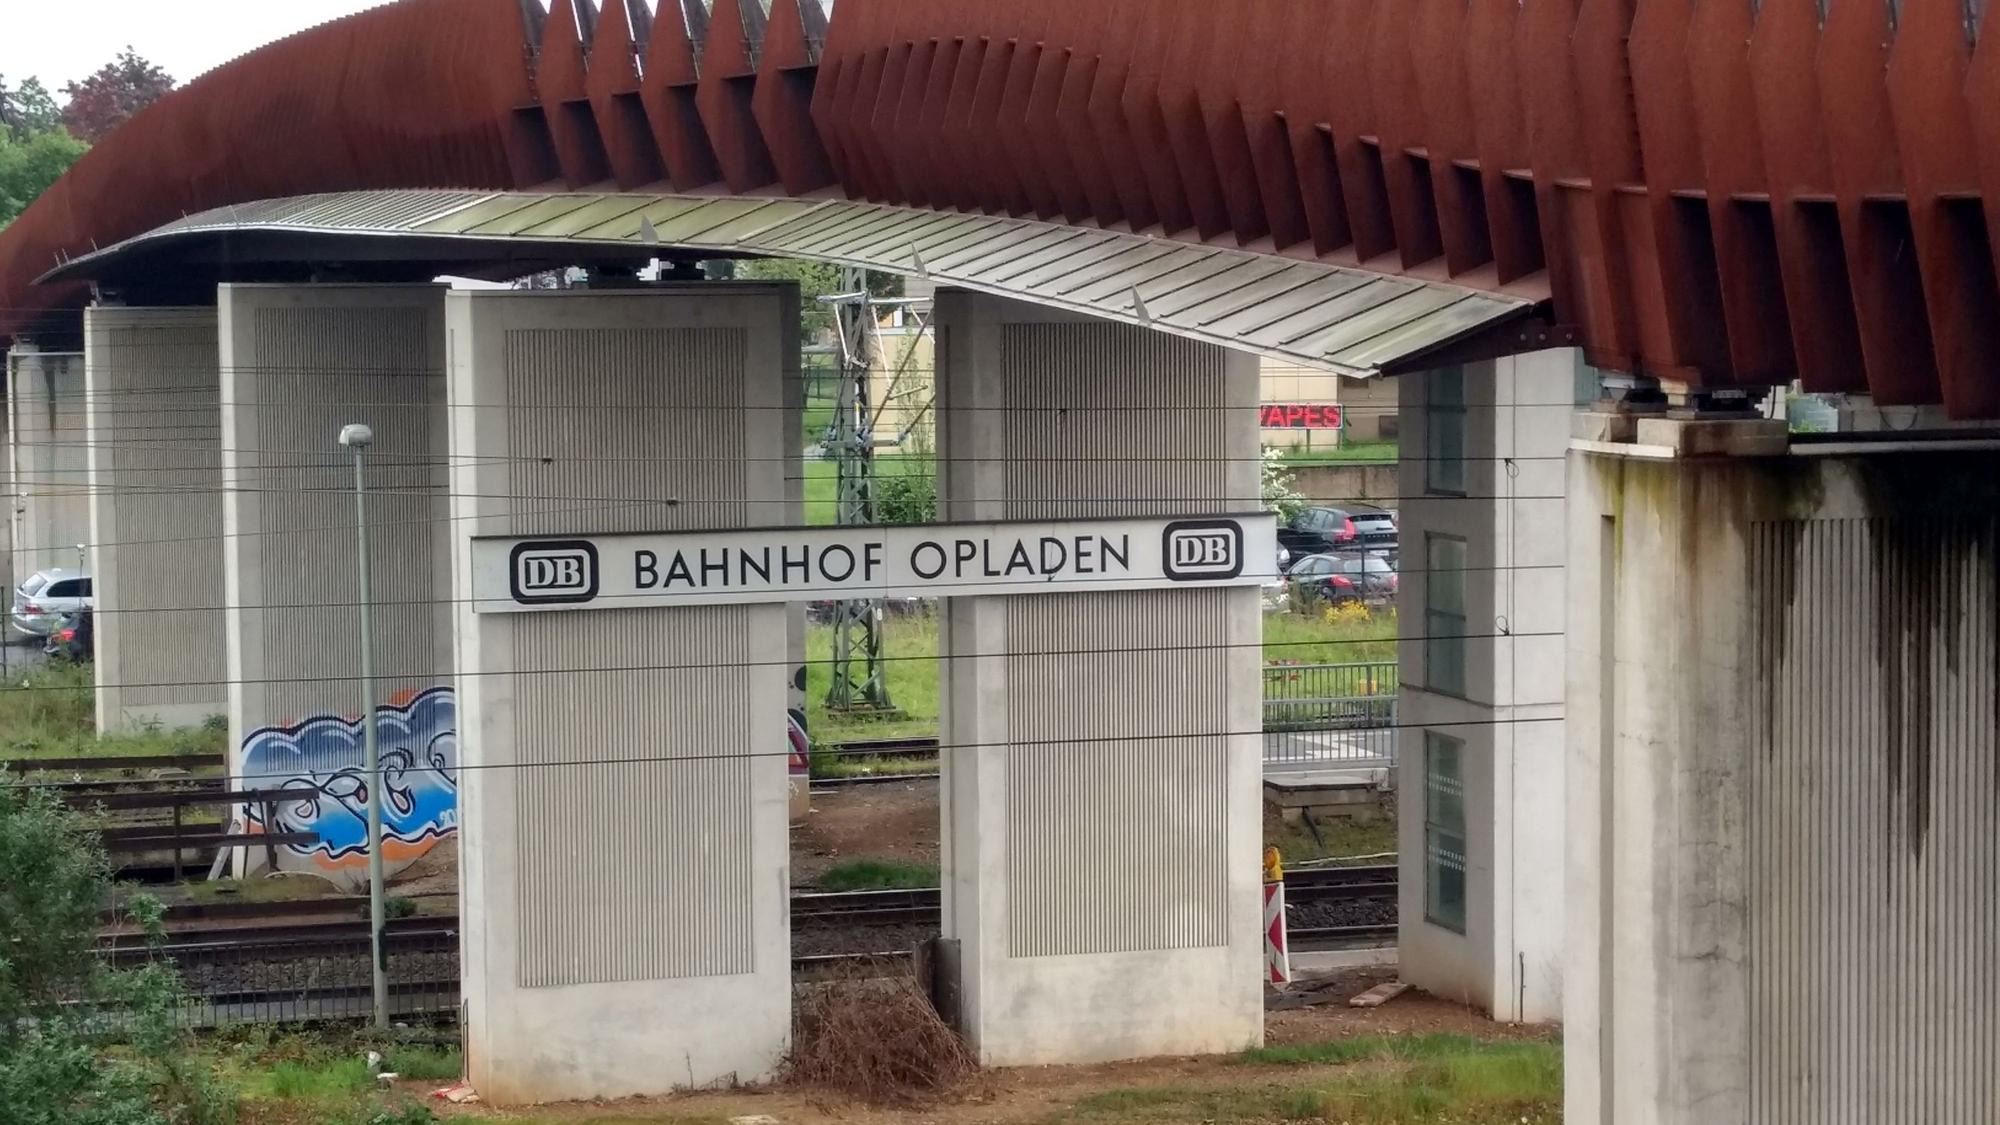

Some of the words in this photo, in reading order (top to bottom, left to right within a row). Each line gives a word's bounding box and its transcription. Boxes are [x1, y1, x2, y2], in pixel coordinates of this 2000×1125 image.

[524, 556, 582, 588] DB
[634, 543, 882, 589] BAHNHOF
[910, 535, 1129, 580] OPLADEN
[1177, 535, 1228, 566] DB
